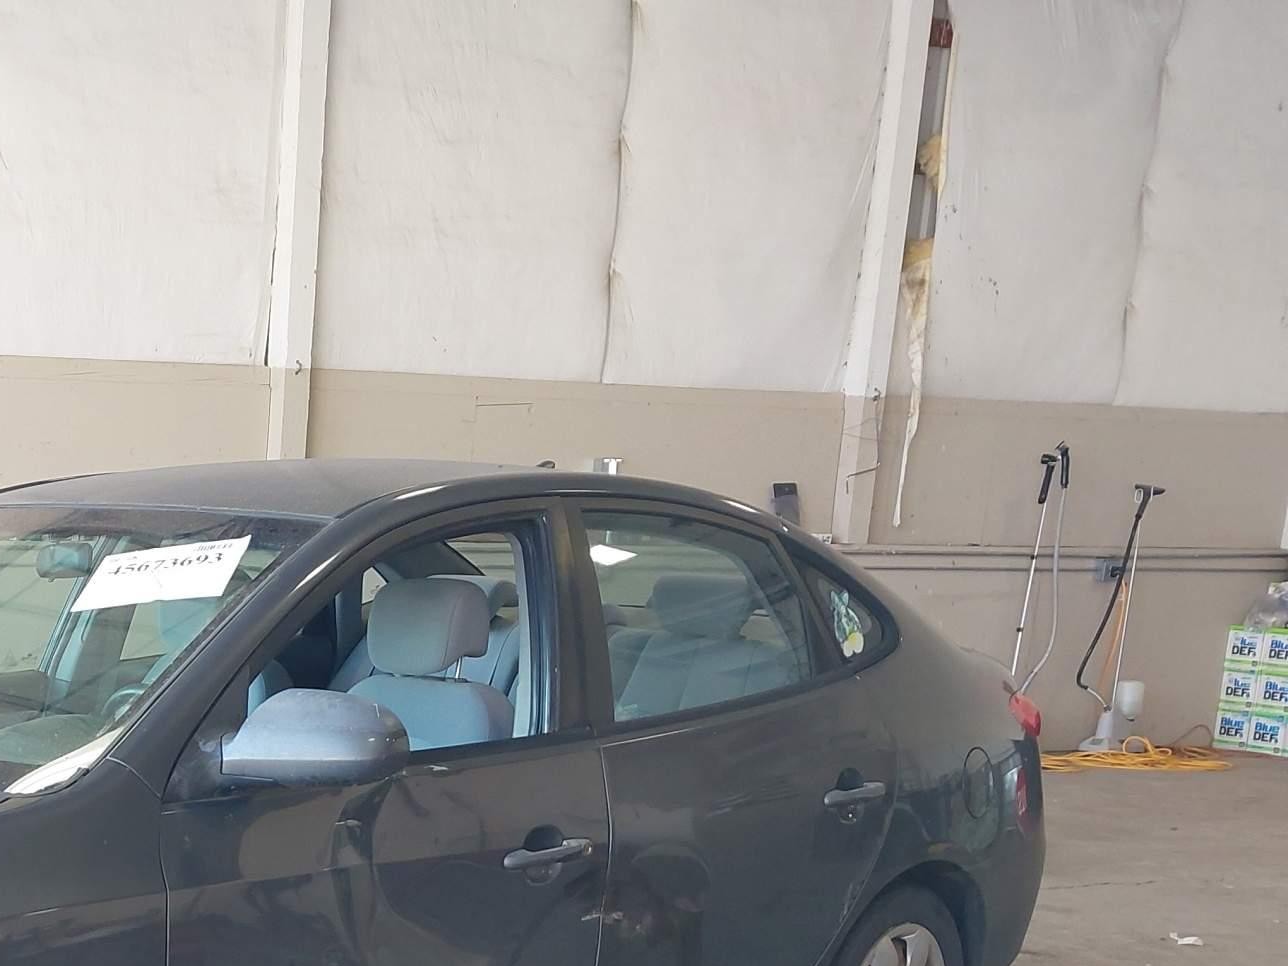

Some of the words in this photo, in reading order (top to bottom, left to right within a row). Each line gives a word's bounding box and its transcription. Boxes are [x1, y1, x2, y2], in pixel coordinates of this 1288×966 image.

[108, 552, 224, 576] 45673693
[1221, 716, 1245, 728] Blue
[1255, 721, 1280, 735] Blue
[1219, 725, 1244, 737] DEF
[1253, 731, 1279, 744] DEF
